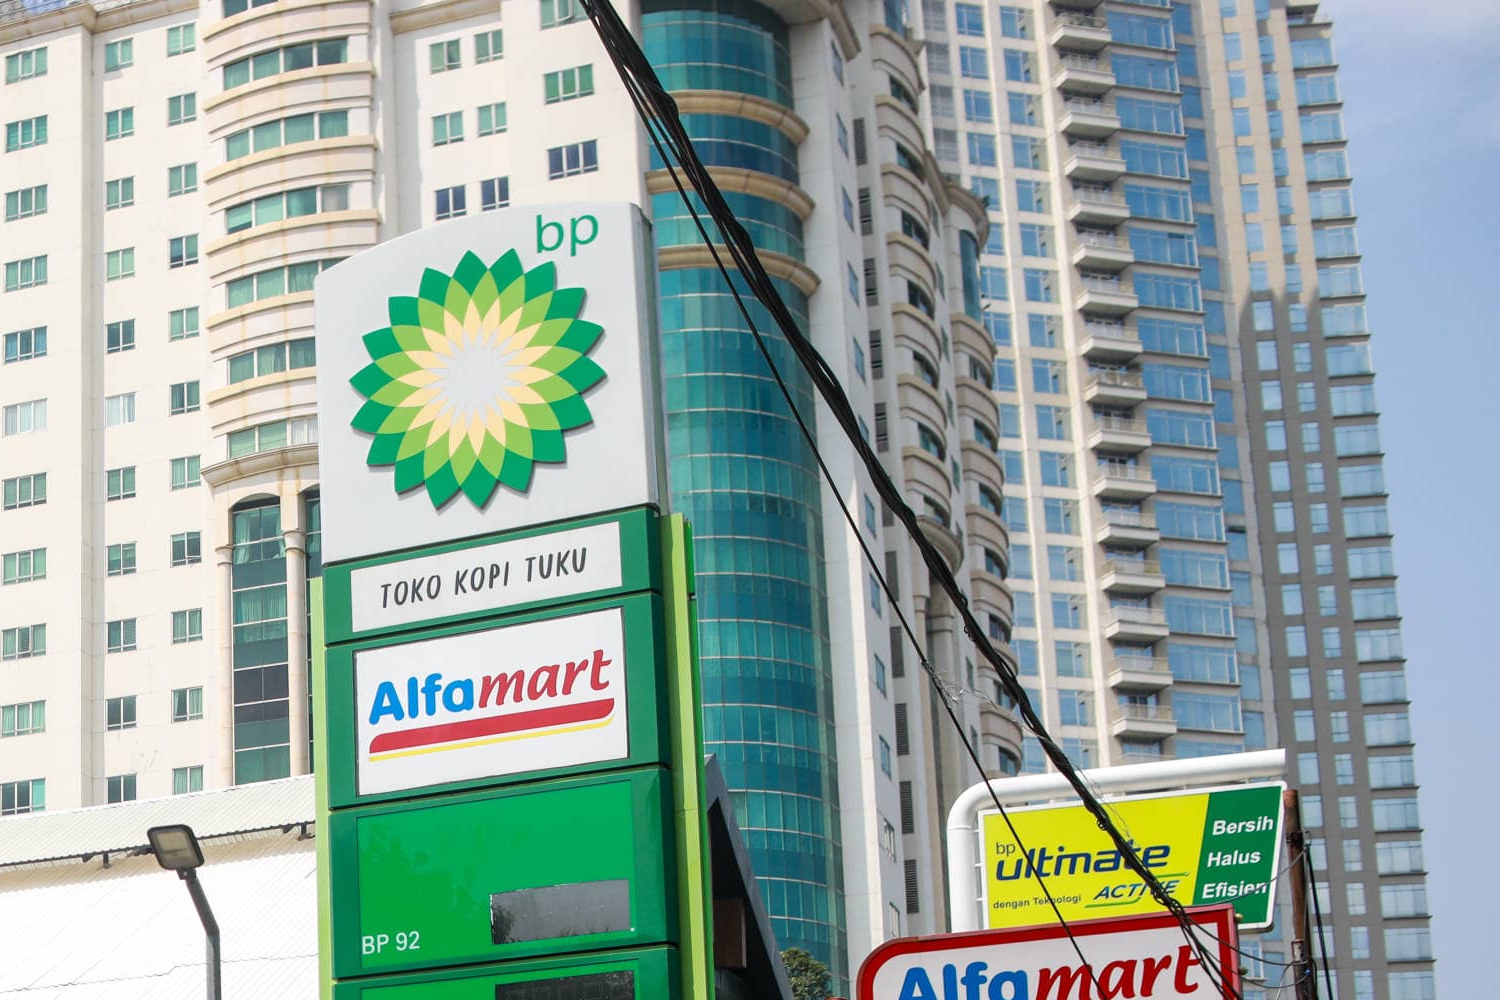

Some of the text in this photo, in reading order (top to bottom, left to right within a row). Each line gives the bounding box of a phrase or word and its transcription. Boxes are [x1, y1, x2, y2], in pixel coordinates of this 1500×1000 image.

[534, 213, 600, 257] bp
[380, 547, 587, 609] TOKO KOPI TUKU
[368, 649, 613, 726] Alfamart
[1212, 815, 1274, 836] Bersih
[995, 841, 1016, 857] bp
[1206, 849, 1261, 868] Halus
[1202, 881, 1268, 899] Efisien
[993, 899, 1030, 909] dengan
[361, 930, 420, 955] BP 92
